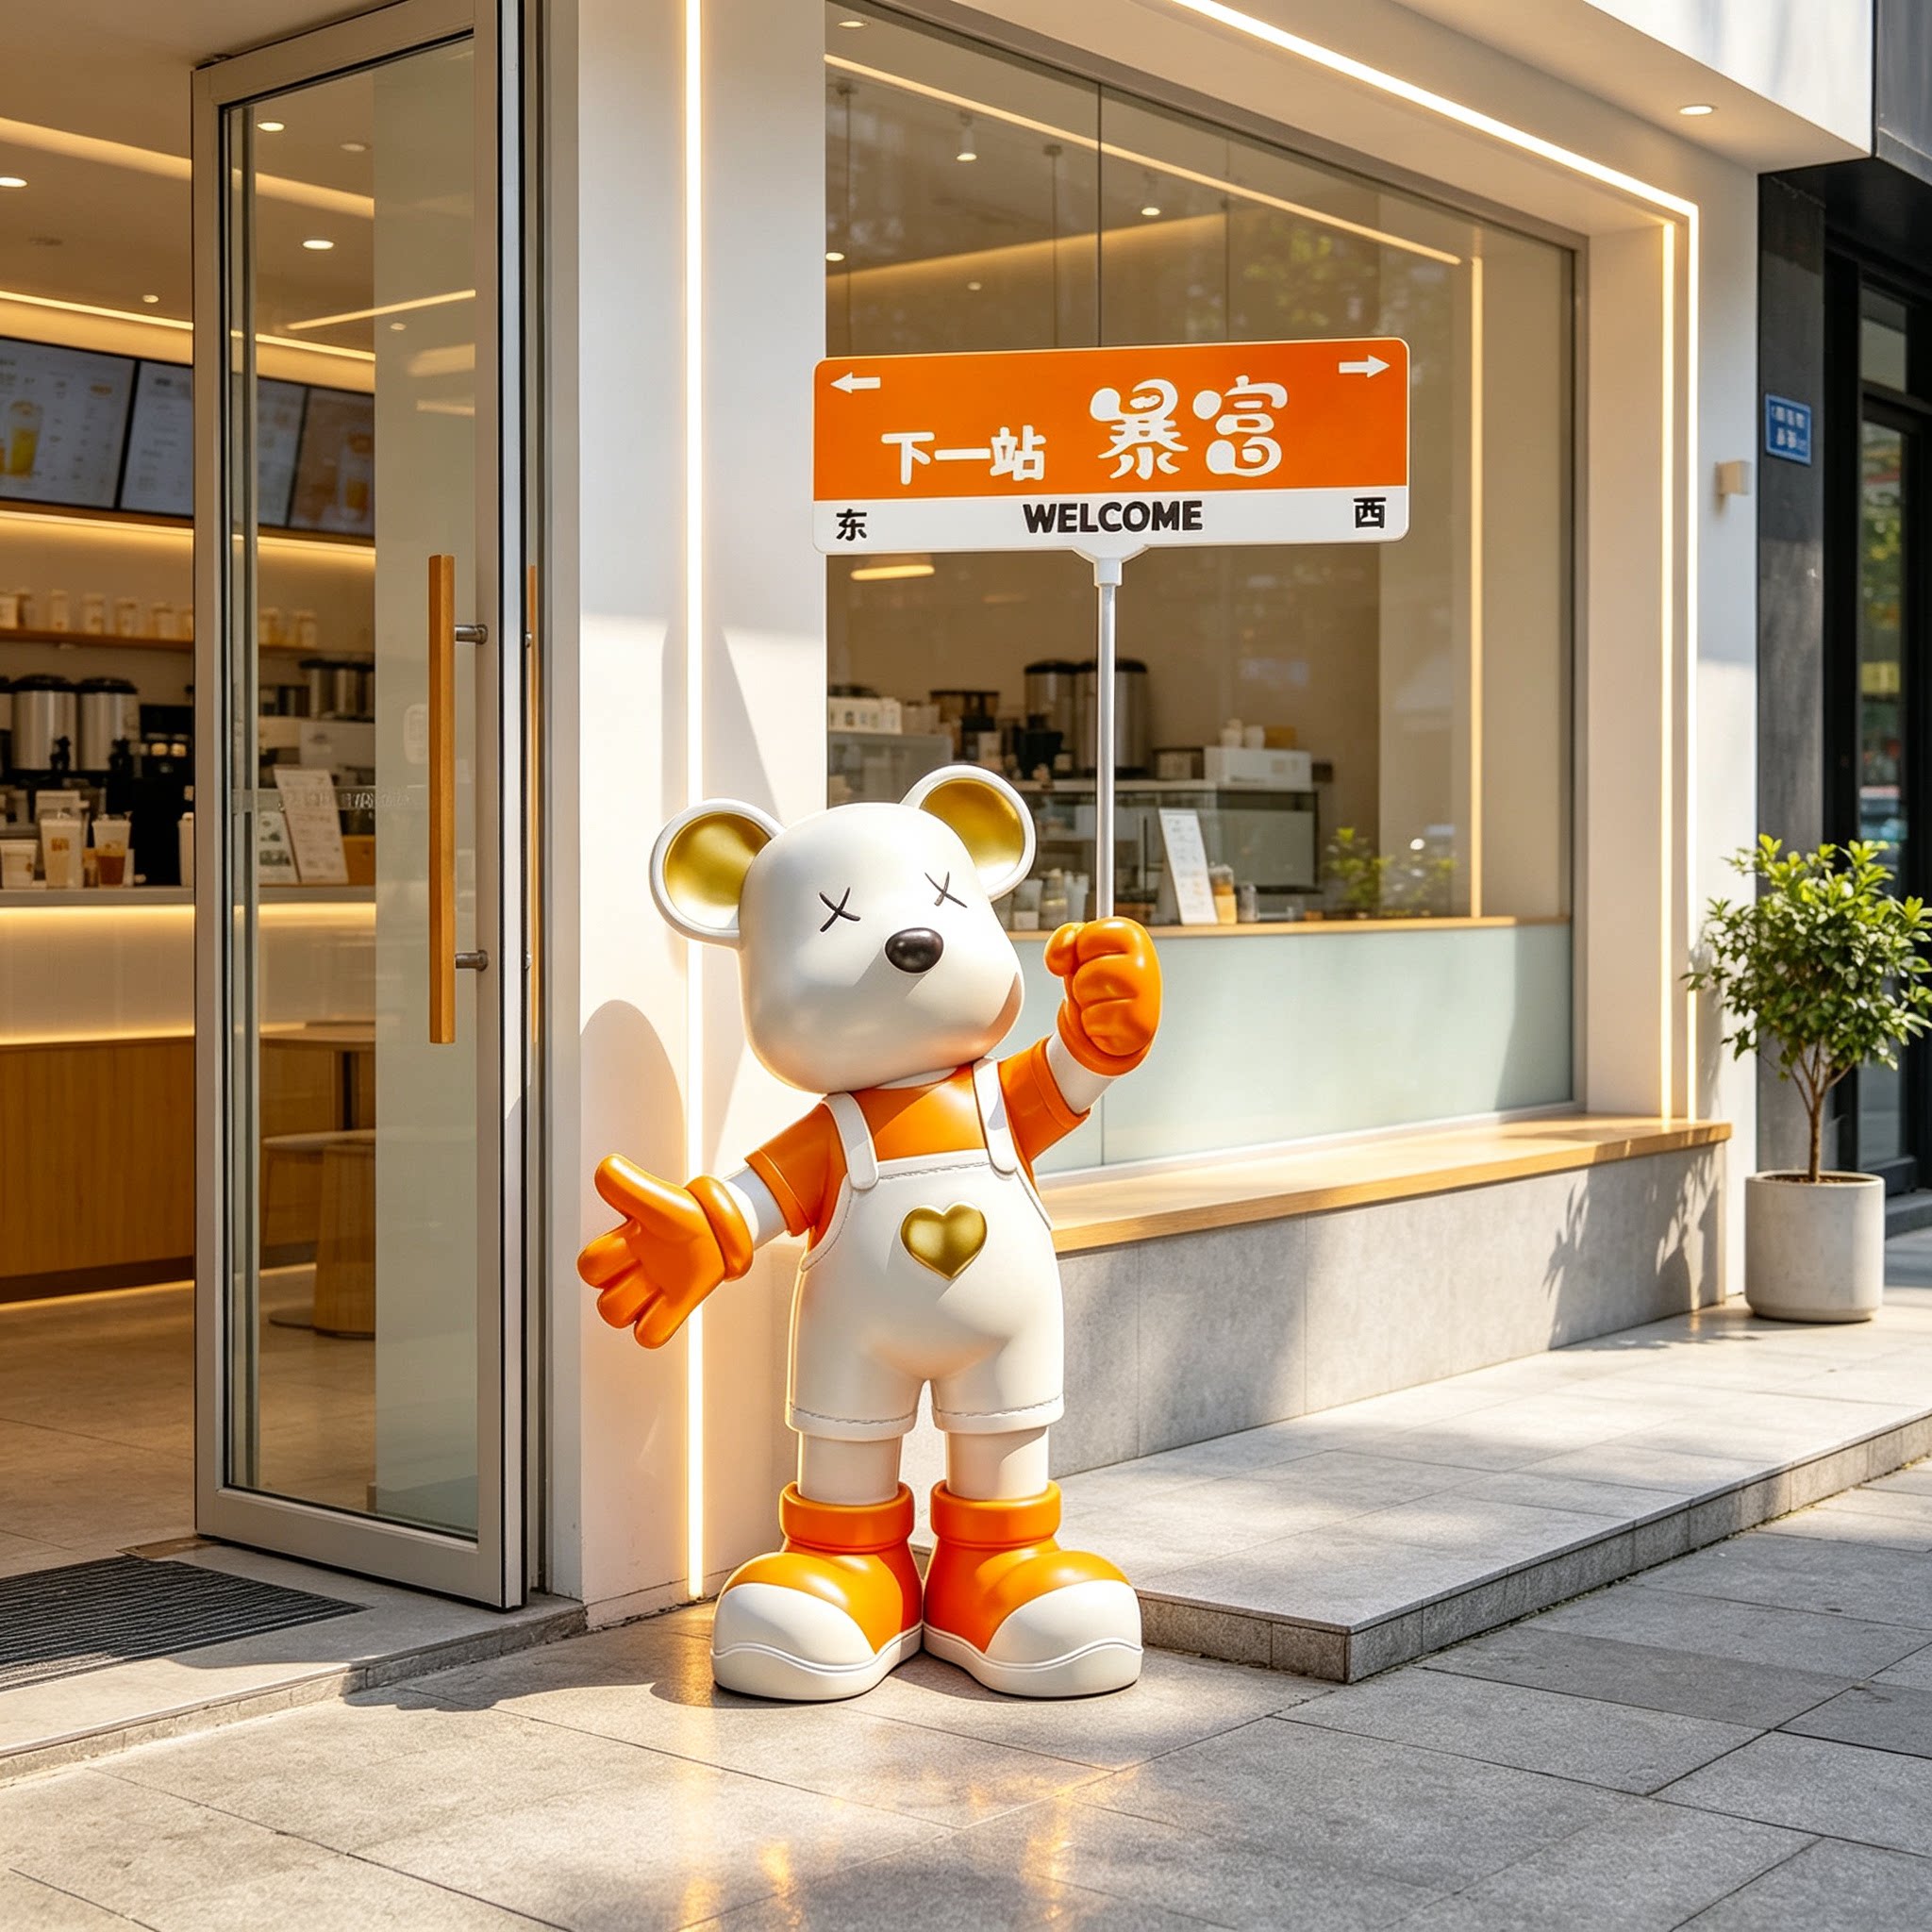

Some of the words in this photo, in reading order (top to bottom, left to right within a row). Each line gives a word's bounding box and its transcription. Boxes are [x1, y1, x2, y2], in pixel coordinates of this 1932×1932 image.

[882, 425, 1046, 485] 下一站
[1091, 376, 1288, 479] 暴富
[836, 508, 868, 541] 东
[1024, 501, 1203, 533] WELCOME
[1354, 497, 1386, 528] 西
